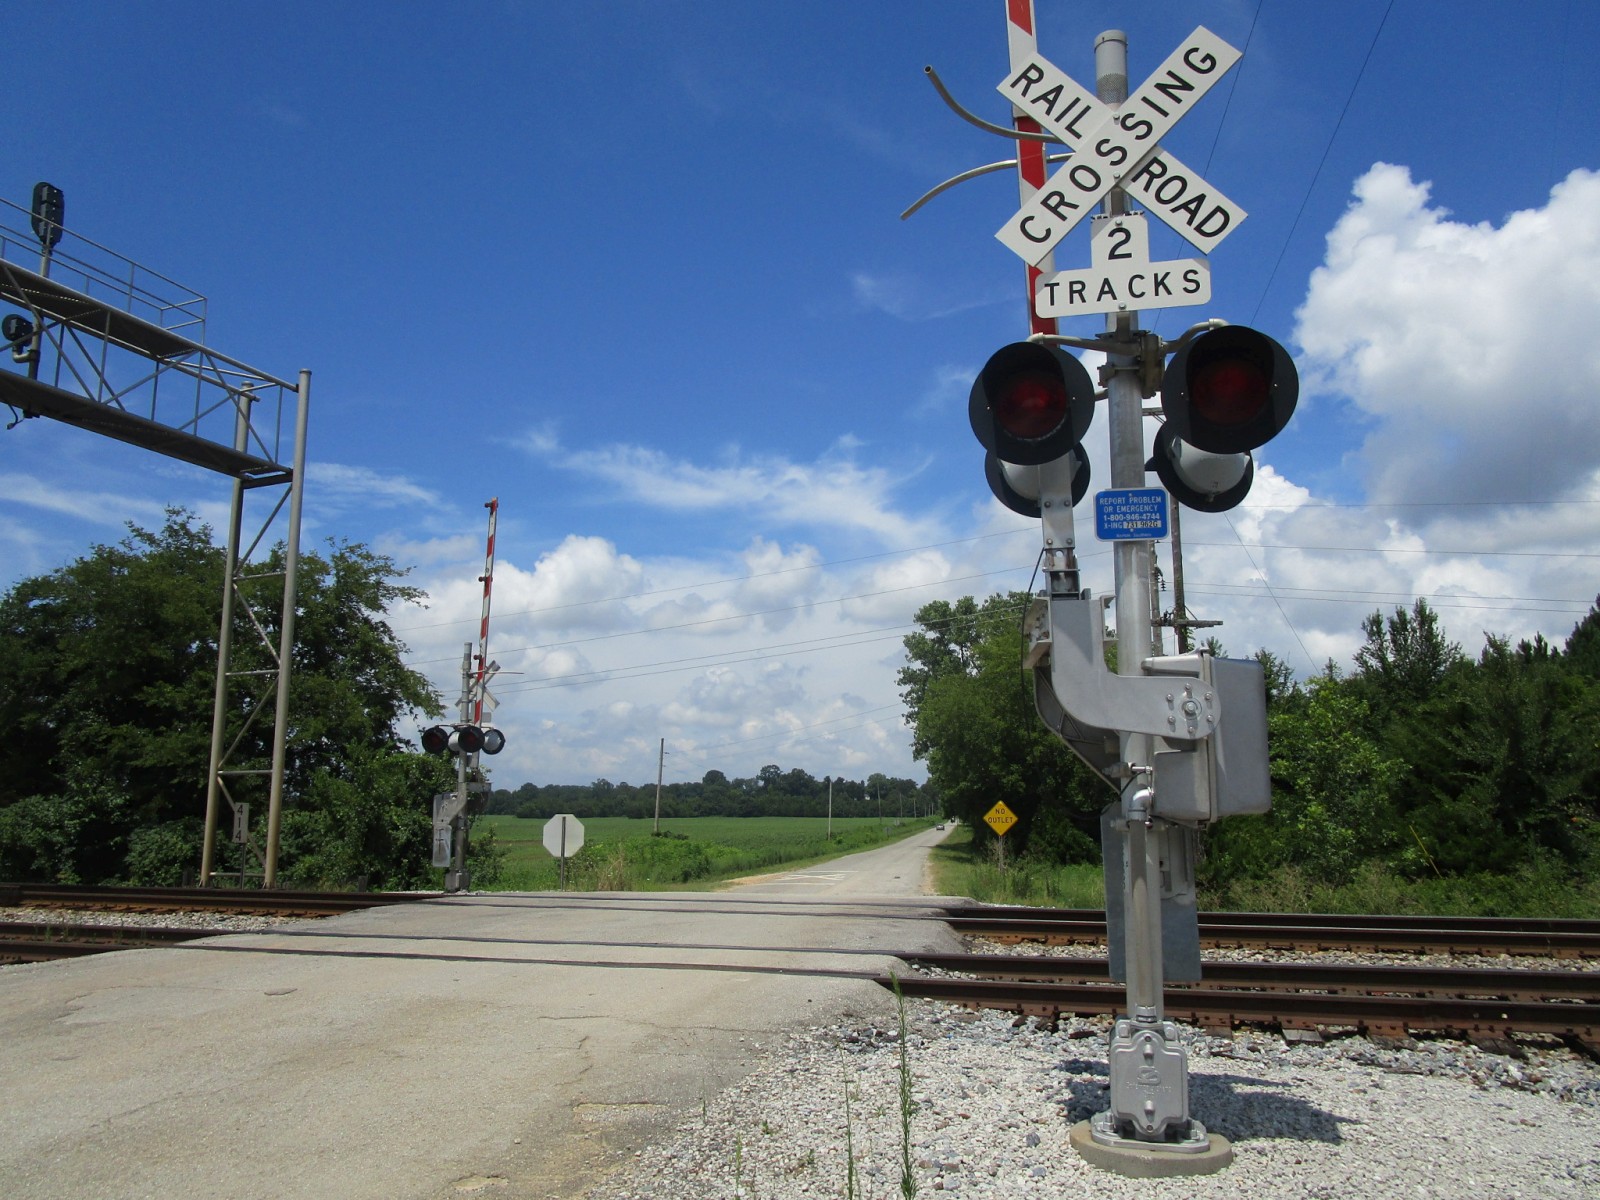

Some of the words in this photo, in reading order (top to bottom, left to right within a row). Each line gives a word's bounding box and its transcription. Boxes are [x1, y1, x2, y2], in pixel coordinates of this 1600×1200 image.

[1010, 63, 1091, 139] RAIL
[1131, 157, 1230, 238] ROAD
[1020, 47, 1217, 243] CROSSING
[1107, 227, 1132, 260] 2
[1044, 269, 1201, 306] TRACKS
[1100, 497, 1126, 505] REPORT
[1129, 496, 1162, 504] PROBLEM
[1103, 505, 1114, 513] OR
[1116, 504, 1158, 513] EMERGENCY
[988, 816, 1013, 824] OUTLET
